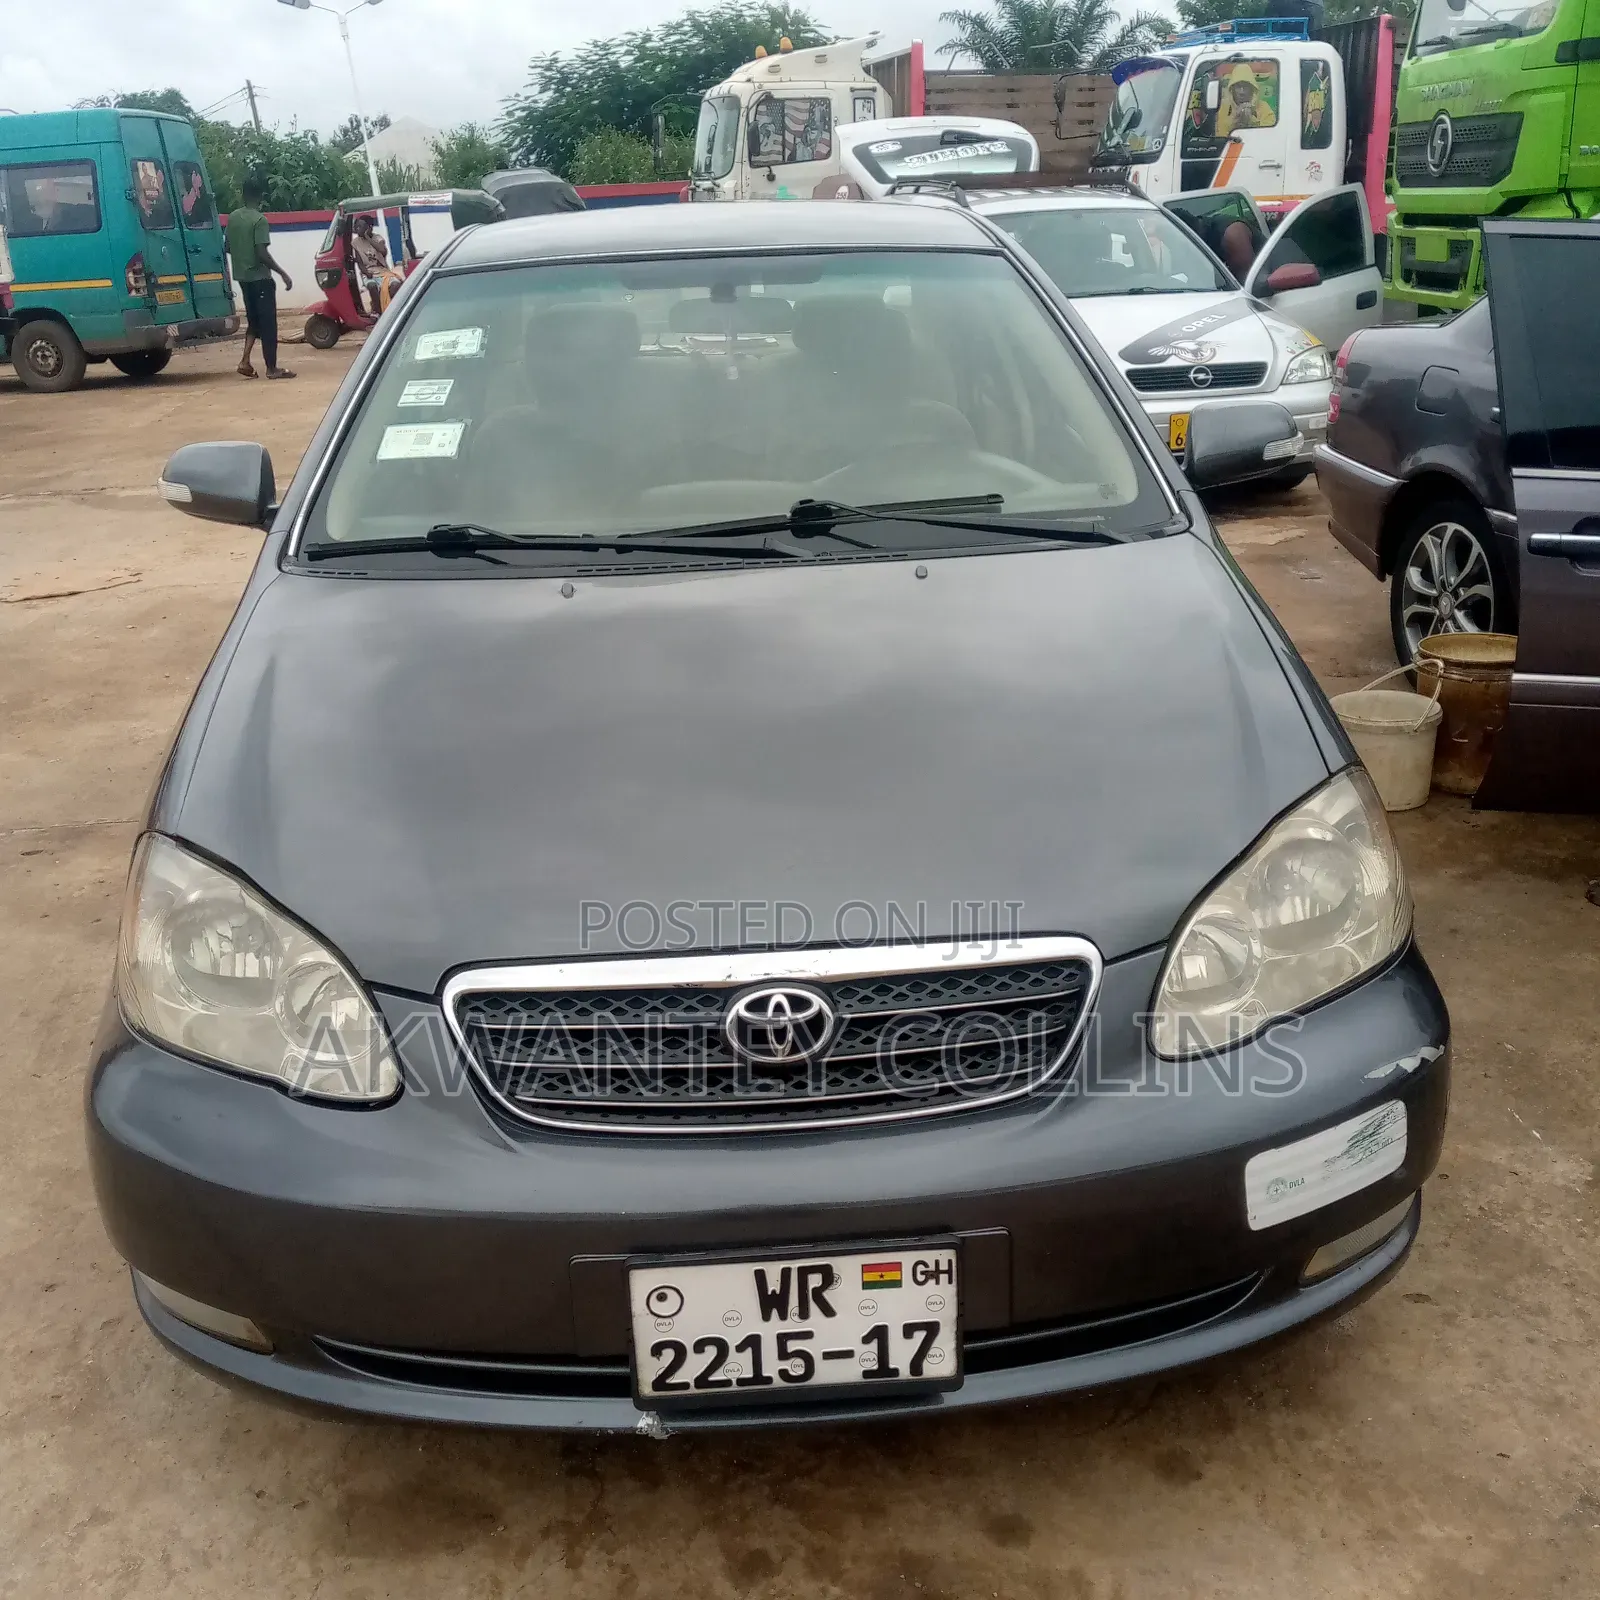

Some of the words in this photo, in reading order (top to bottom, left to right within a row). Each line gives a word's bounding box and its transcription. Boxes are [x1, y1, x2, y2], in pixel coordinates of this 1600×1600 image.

[1182, 313, 1227, 332] OPEL
[1288, 1177, 1306, 1189] DVLA
[912, 1258, 954, 1286] GH
[754, 1263, 838, 1322] WR
[650, 1321, 940, 1392] 2215-17
